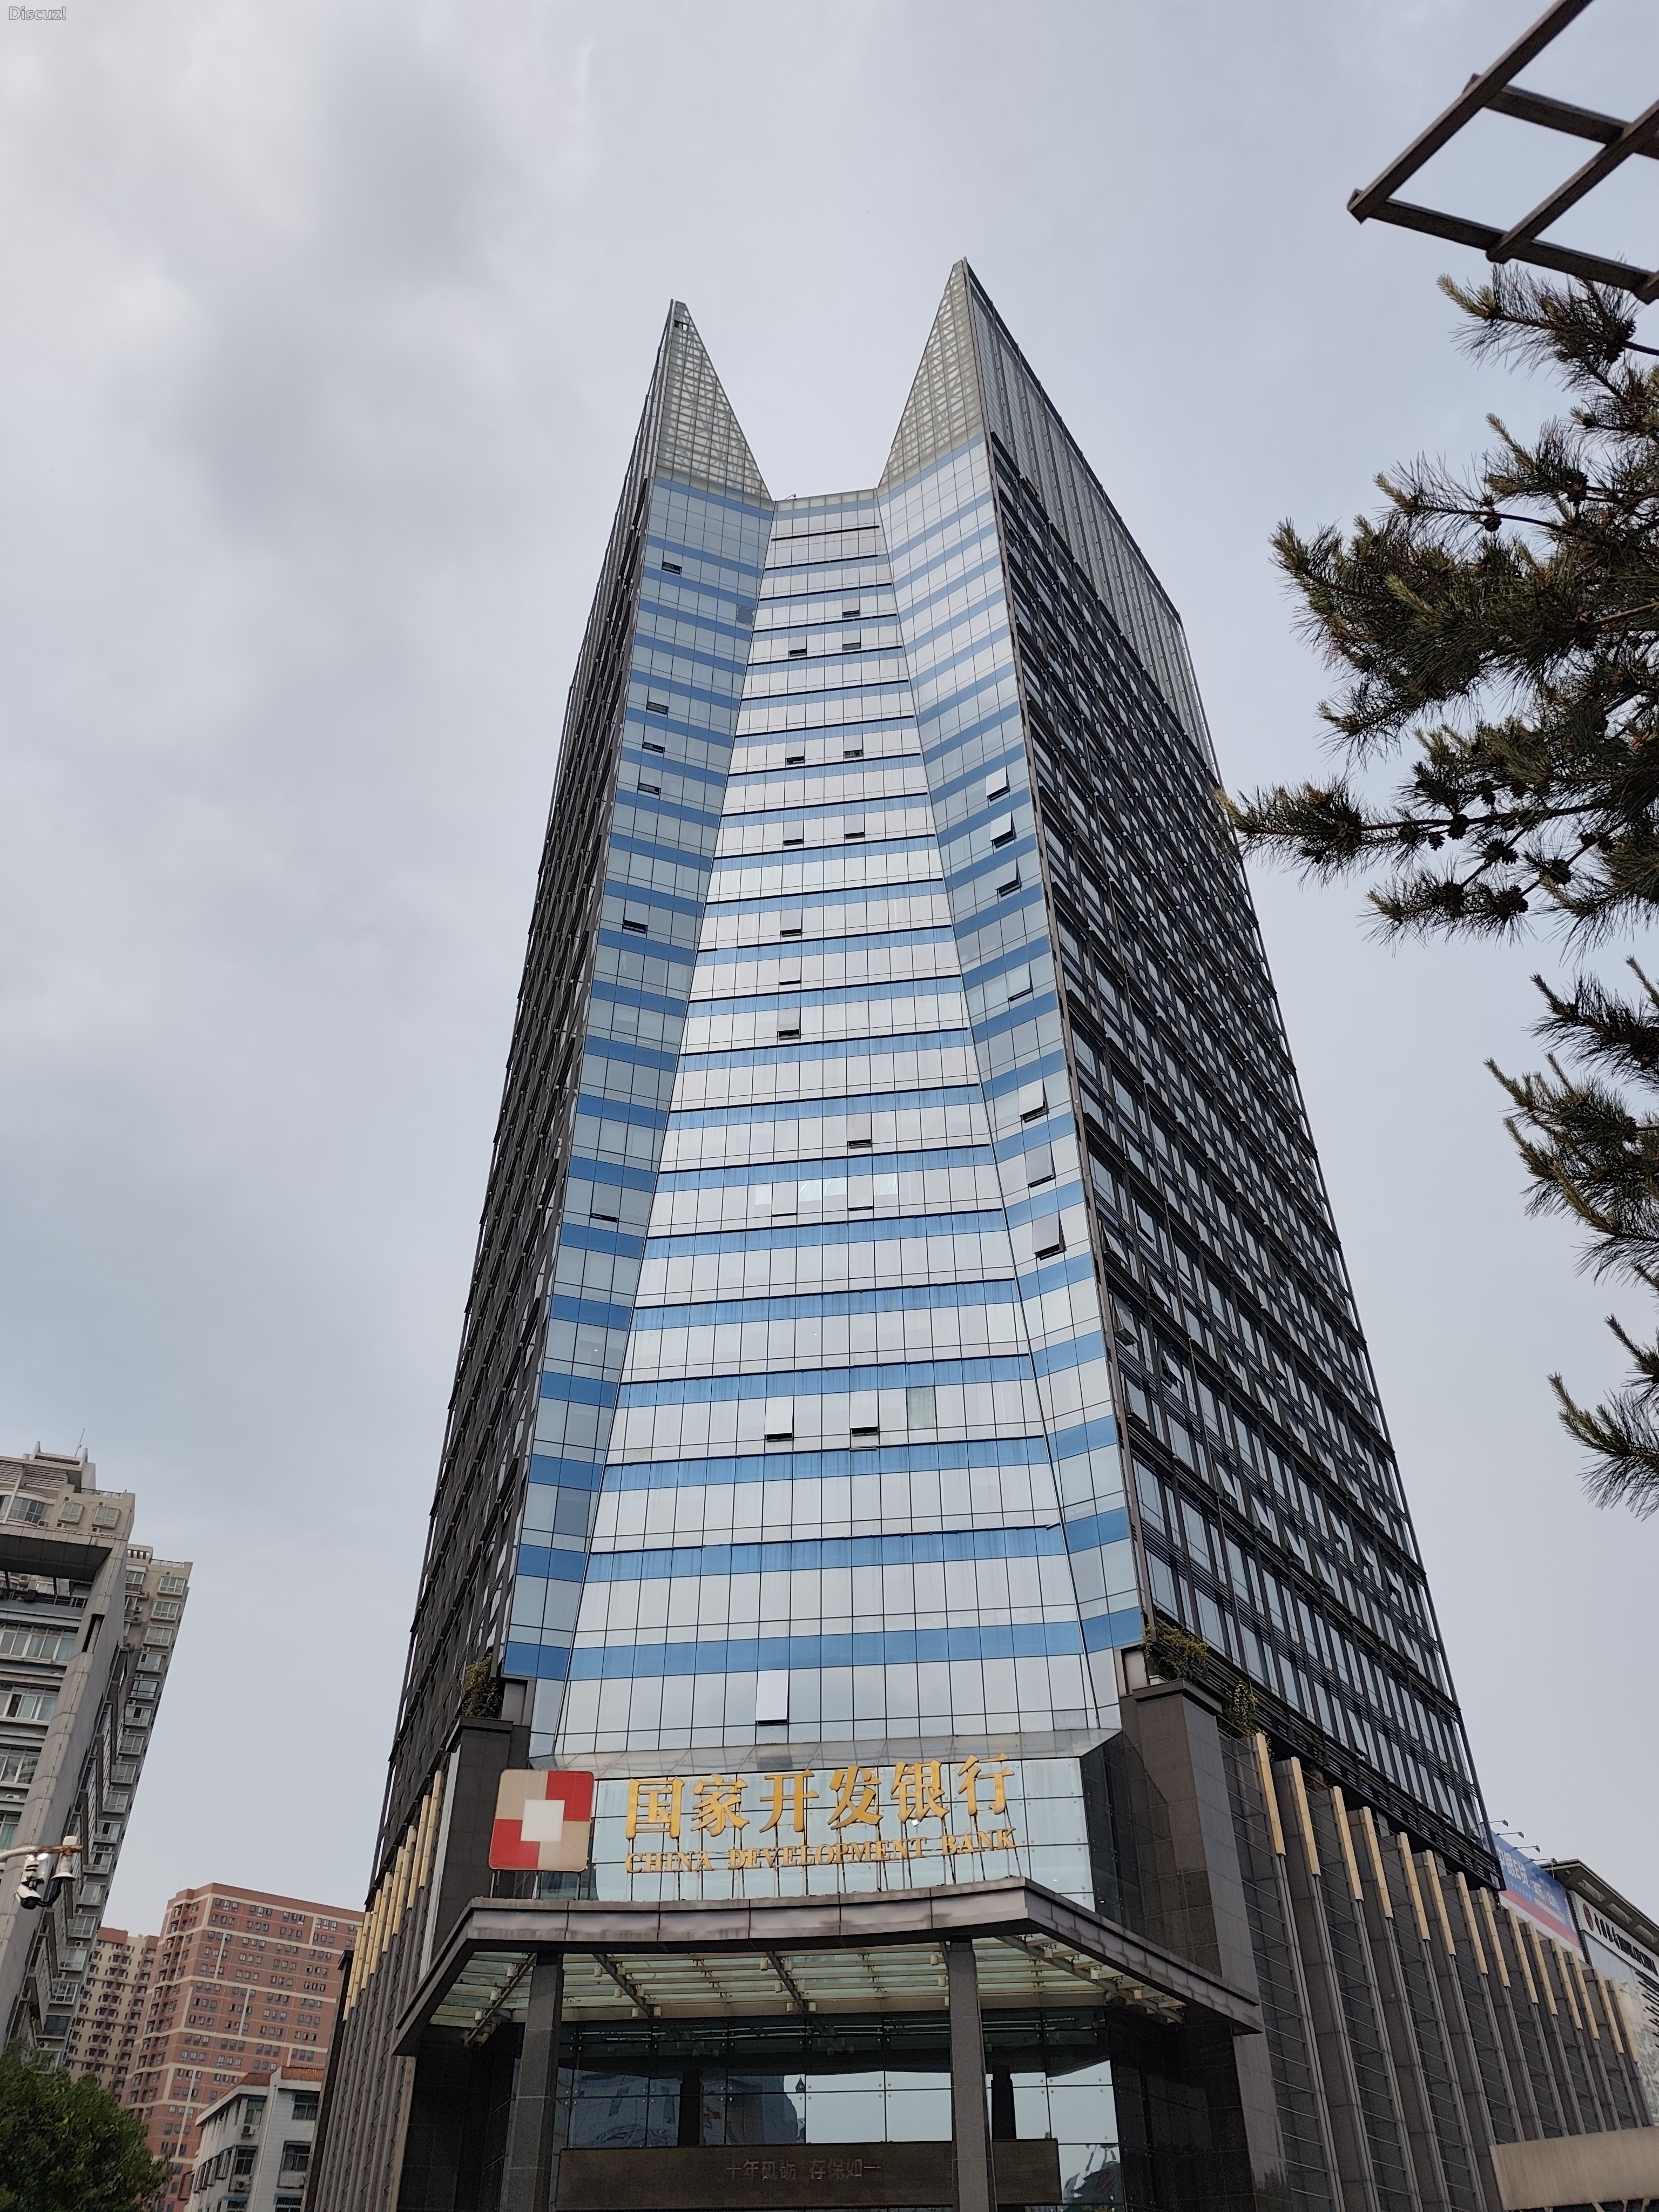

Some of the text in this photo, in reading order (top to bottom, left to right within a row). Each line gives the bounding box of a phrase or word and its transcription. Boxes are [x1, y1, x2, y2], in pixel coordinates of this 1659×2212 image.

[626, 1752, 1015, 1839] 国家开发银行
[625, 1827, 1016, 1873] CHINA DEVELOPMENT BANK
